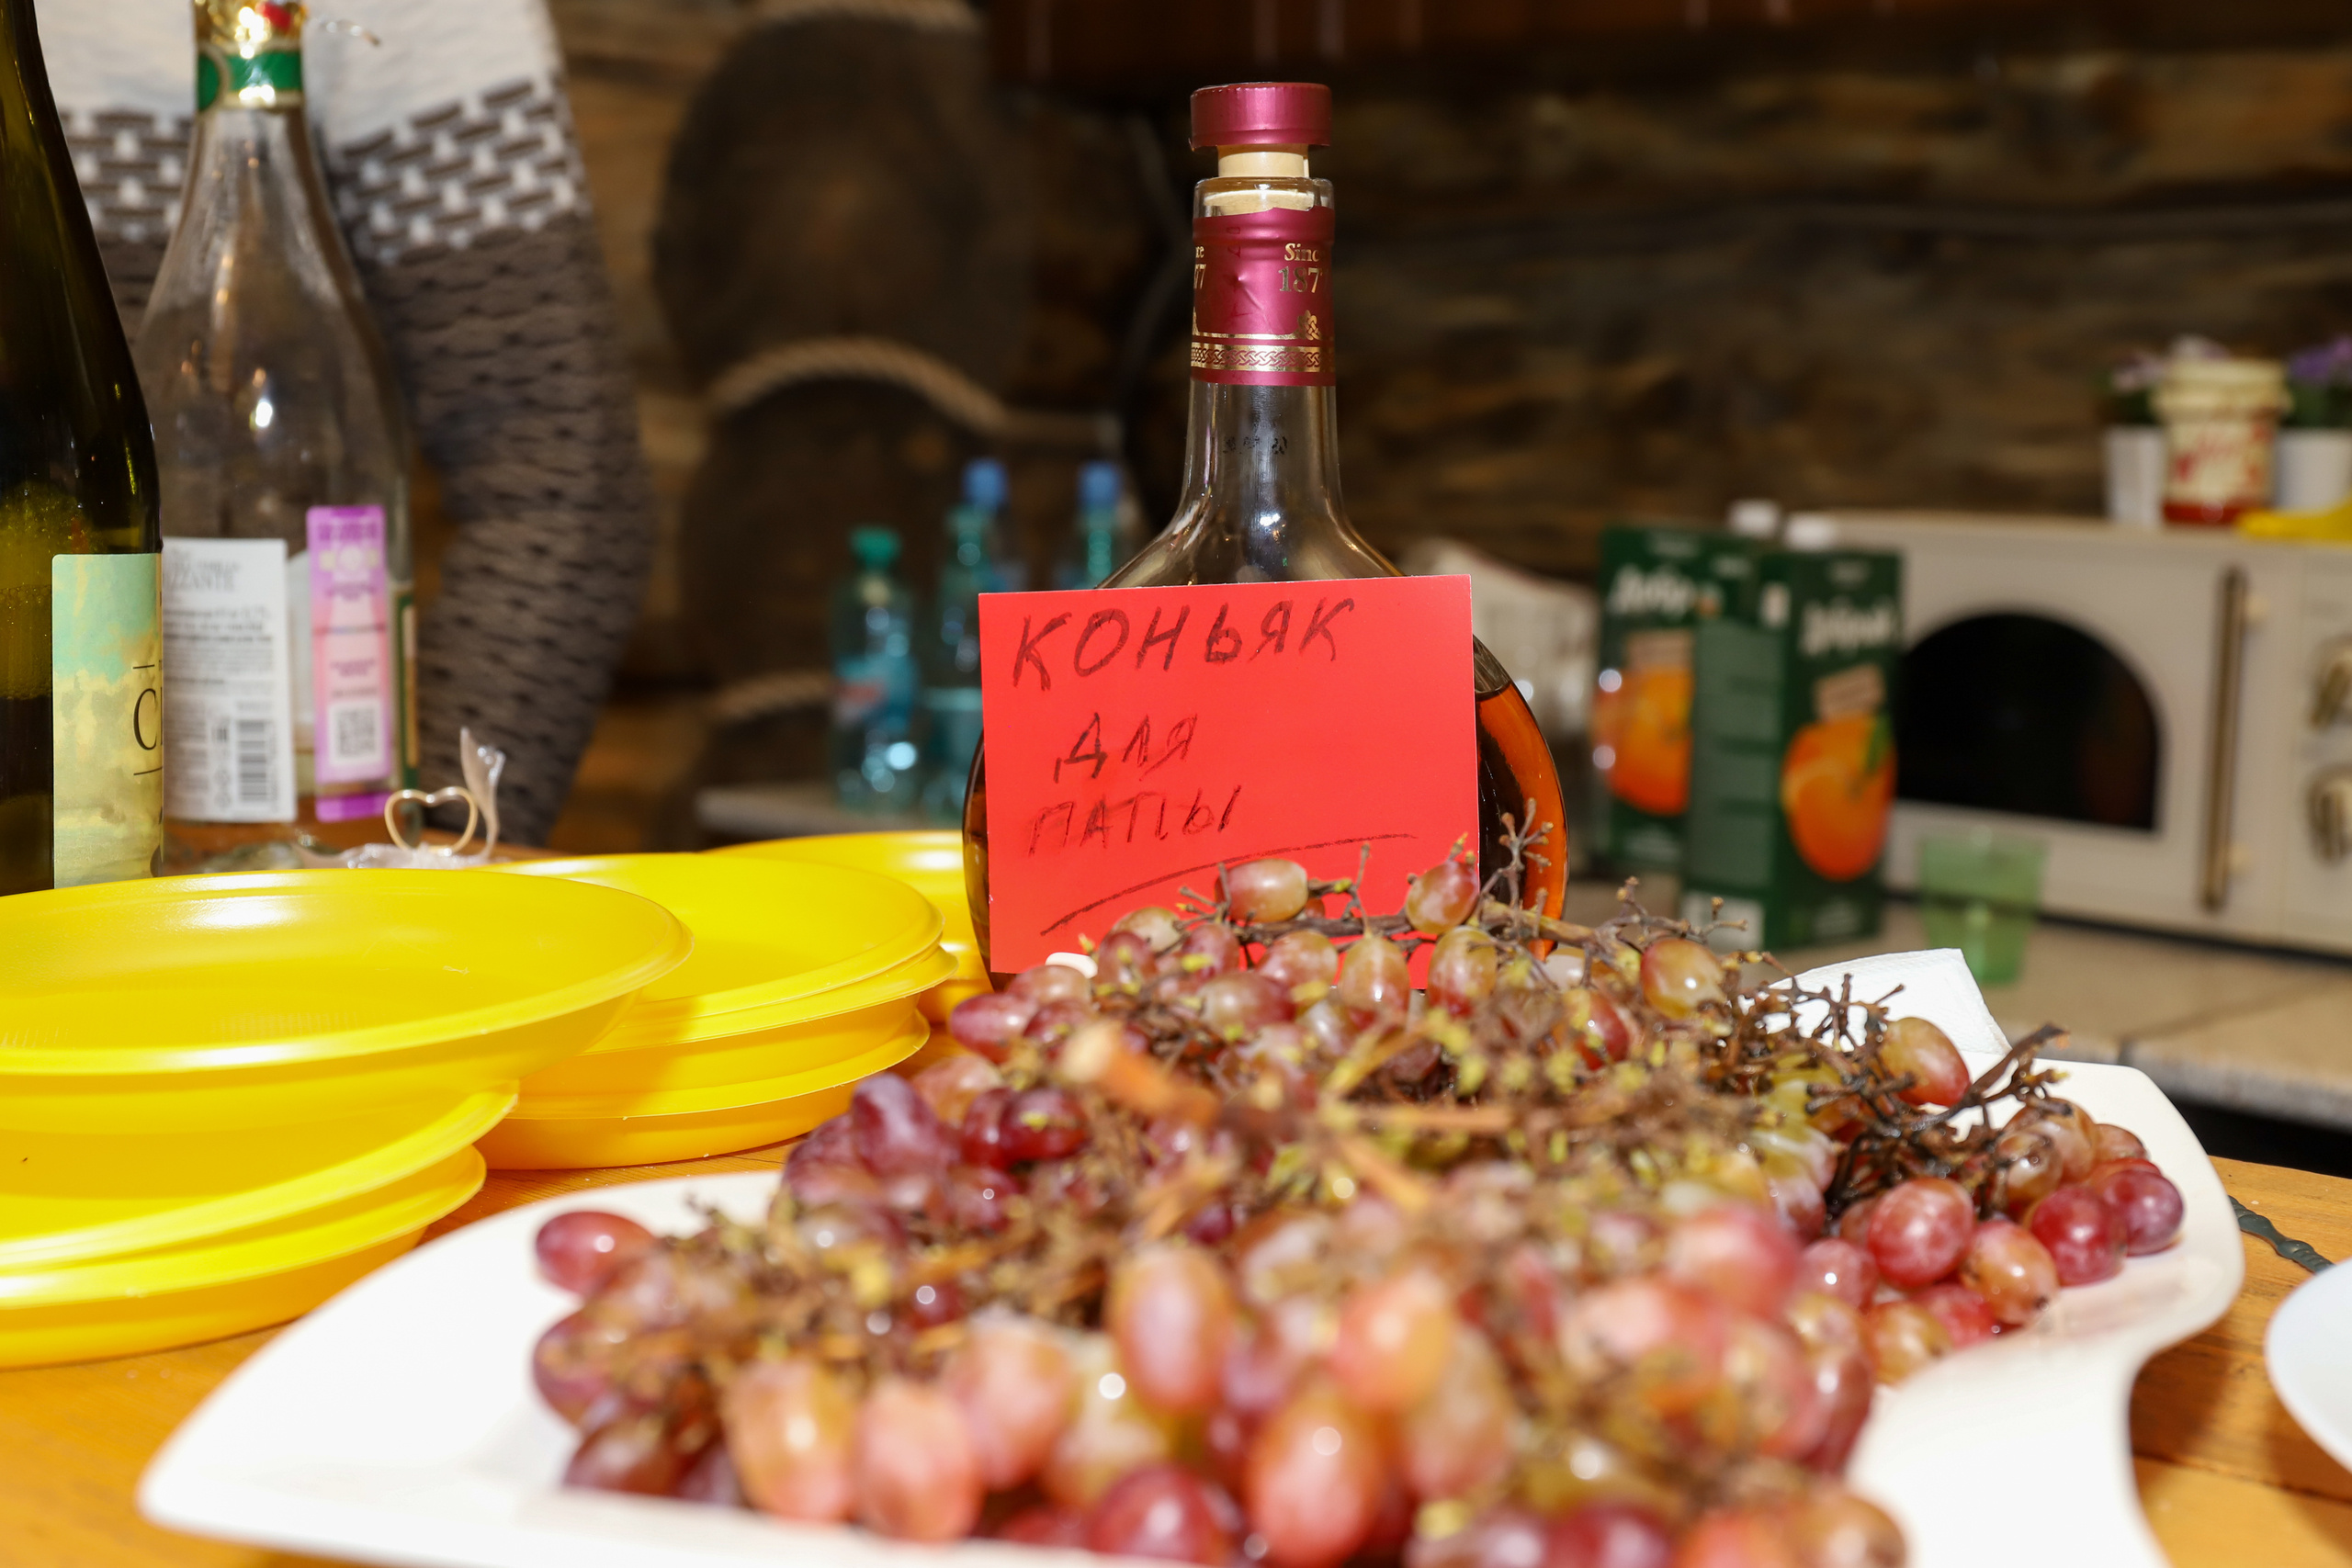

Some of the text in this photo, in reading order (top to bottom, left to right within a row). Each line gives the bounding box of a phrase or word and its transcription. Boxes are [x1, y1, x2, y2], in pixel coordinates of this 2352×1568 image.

[1278, 265, 1323, 294] 187
[1283, 243, 1323, 262] Sinc
[1012, 598, 1354, 691] КОНЬЯК
[1054, 711, 1198, 783] ДЛЯ
[1027, 784, 1242, 856] ПАПЫ
